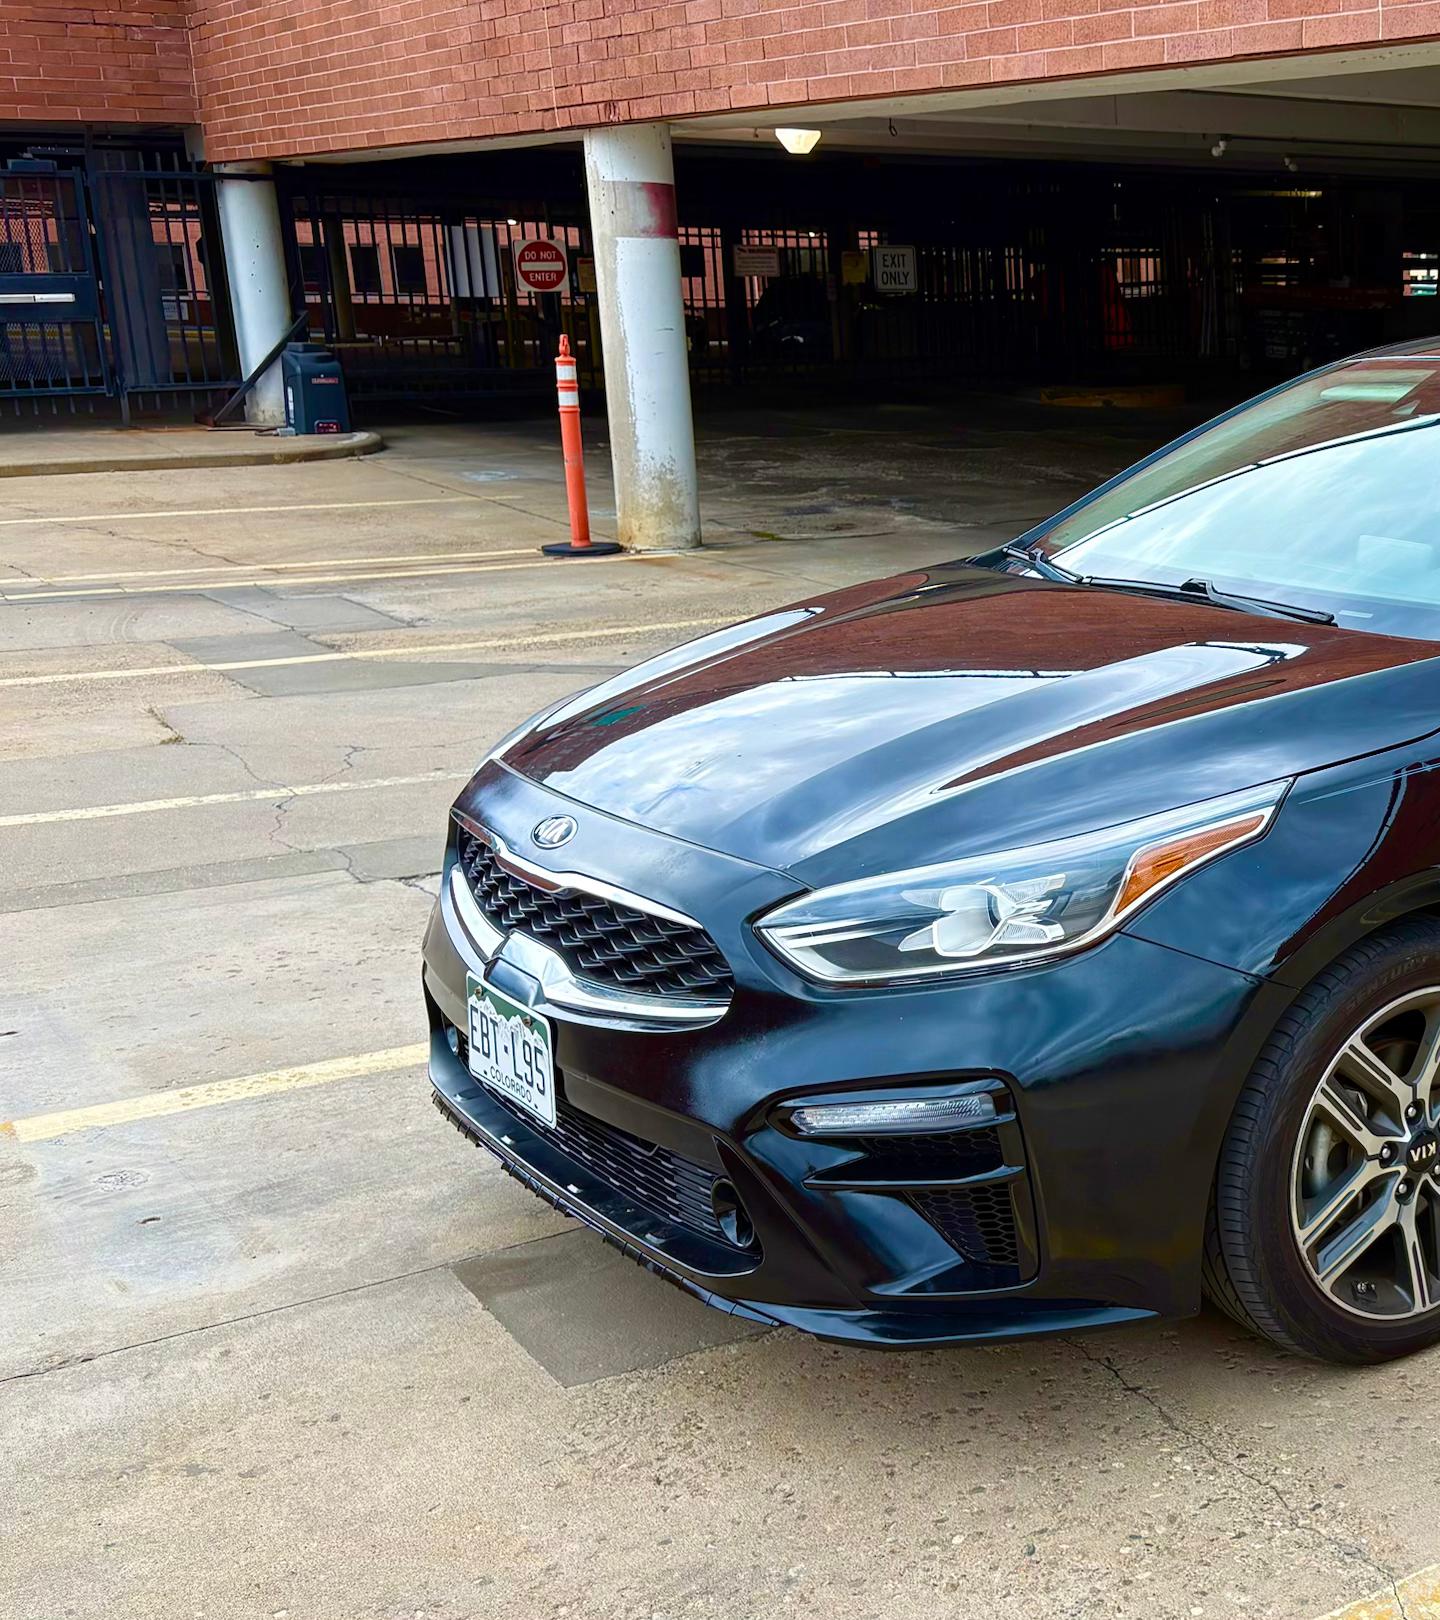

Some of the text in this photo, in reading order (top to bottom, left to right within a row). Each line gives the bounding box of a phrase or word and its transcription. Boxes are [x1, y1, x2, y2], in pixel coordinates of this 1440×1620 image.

[524, 250, 557, 261] DO NOT
[882, 254, 907, 268] EXIT
[529, 272, 557, 282] ENTER
[881, 271, 910, 285] ONLY
[490, 1065, 533, 1104] COLORADO
[1409, 1141, 1437, 1162] KIA
